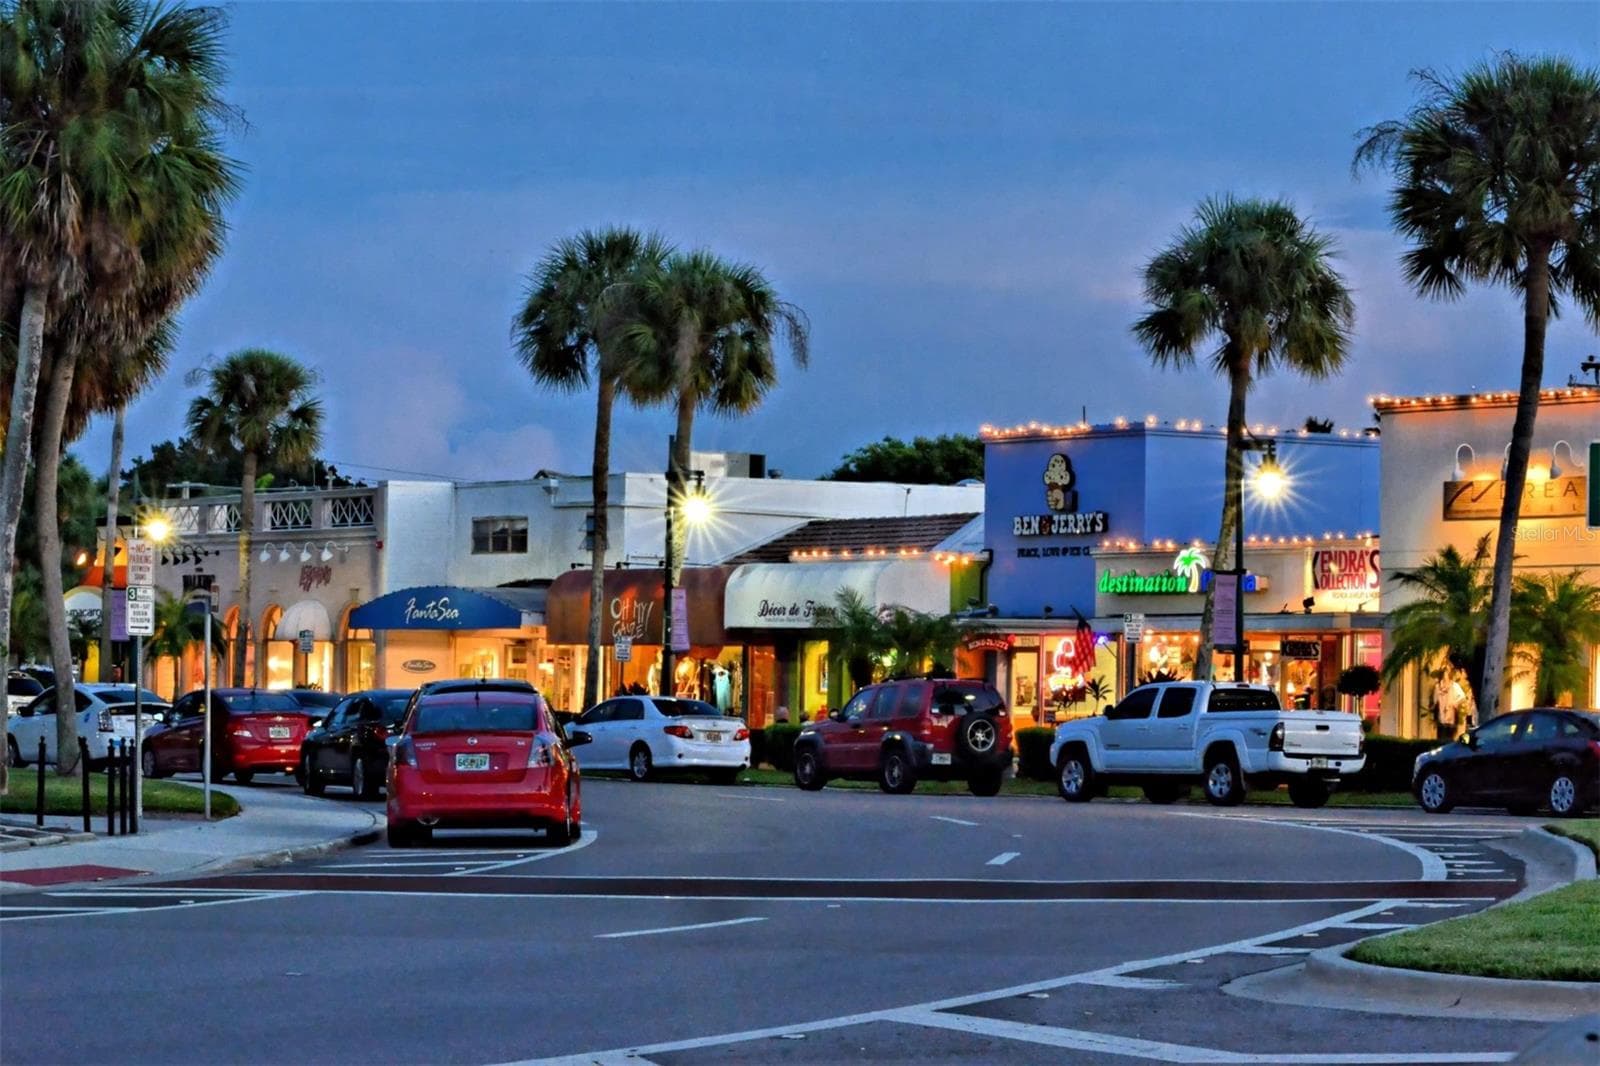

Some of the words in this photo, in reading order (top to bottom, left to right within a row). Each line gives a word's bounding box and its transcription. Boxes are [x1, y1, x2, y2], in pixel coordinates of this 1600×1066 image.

[1500, 480, 1579, 500] REA
[1013, 516, 1039, 535] BEN
[1051, 513, 1103, 534] JERRY'S
[136, 544, 145, 553] NO
[130, 555, 152, 564] PARKING
[1098, 569, 1188, 593] destination
[128, 588, 136, 600] 3
[405, 597, 459, 624] FantaSea
[610, 598, 630, 620] OH
[789, 602, 800, 616] de
